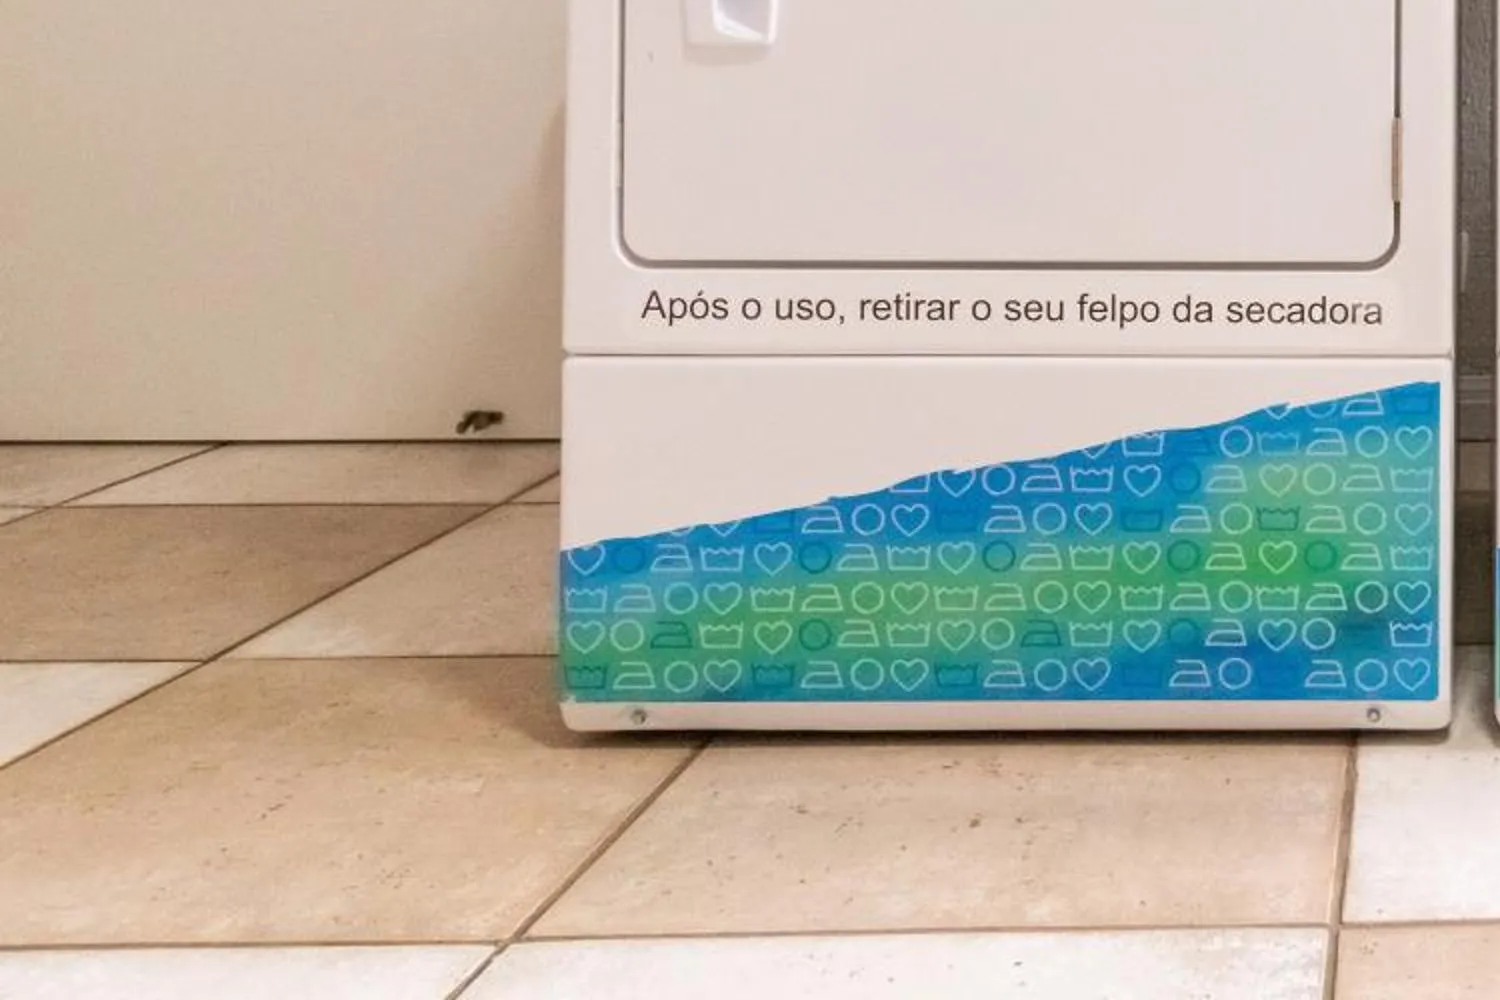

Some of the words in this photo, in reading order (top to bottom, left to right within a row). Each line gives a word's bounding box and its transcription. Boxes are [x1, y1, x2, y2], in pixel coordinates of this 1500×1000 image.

[641, 290, 729, 327] Após
[741, 297, 762, 321] o
[775, 297, 846, 325] uso,
[859, 293, 961, 321] retirar
[972, 299, 992, 321] o
[1003, 299, 1065, 322] seu
[1076, 293, 1161, 329] felpo
[1172, 294, 1214, 323] da
[1226, 295, 1383, 325] secadora
